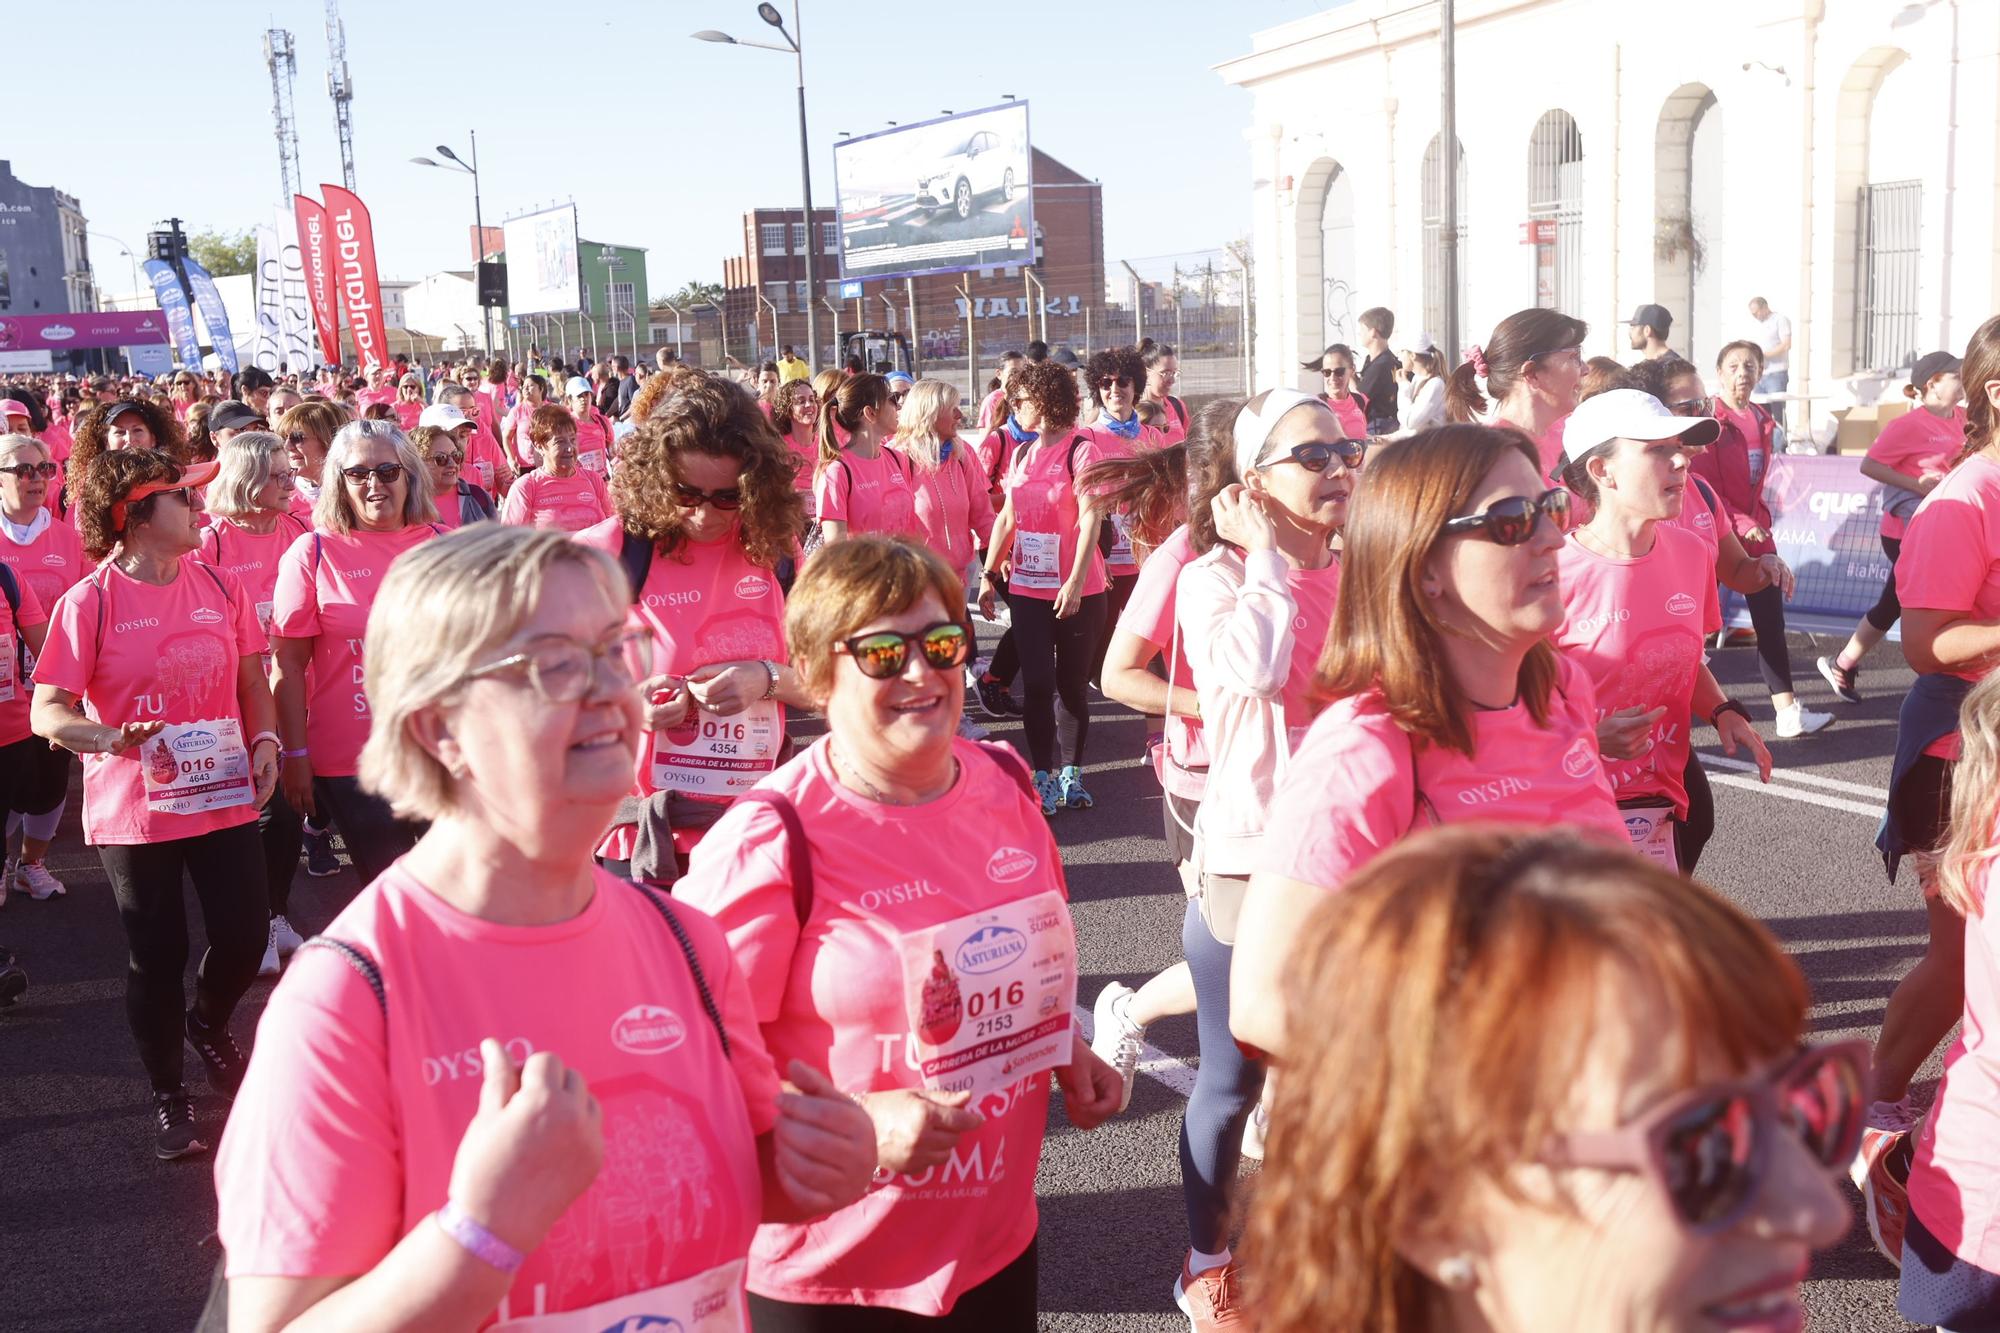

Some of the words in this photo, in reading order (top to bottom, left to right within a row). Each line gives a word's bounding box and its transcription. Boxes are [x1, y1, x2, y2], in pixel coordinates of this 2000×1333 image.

[91, 326, 120, 335] OYSHO
[1809, 490, 1868, 522] que
[230, 560, 263, 574] OYSHO
[1023, 554, 1040, 564] 016
[646, 590, 702, 608] OYSHO
[115, 616, 160, 634] OYSHO
[1577, 608, 1631, 633] OYSHO
[133, 693, 164, 716] TU
[702, 721, 745, 740] 016
[175, 738, 215, 749] ASTURIANA
[710, 742, 738, 755] 4354
[180, 756, 216, 774] 016
[669, 756, 706, 767] CARRERA
[707, 760, 719, 768] DE
[187, 772, 211, 784] 4643
[663, 771, 706, 785] OYSHO
[159, 789, 190, 799] CARRERA
[189, 787, 199, 795] DE
[212, 792, 246, 802] Santander
[158, 801, 191, 812] OYSHO
[1029, 917, 1060, 935] SUMA
[962, 940, 1023, 969] ASTURIANA
[967, 980, 1025, 1018] 016
[976, 1013, 1013, 1037] 2153
[421, 1036, 535, 1086] OYSO
[925, 1051, 974, 1075] CARRERA
[974, 1046, 989, 1058] DE
[989, 1042, 1004, 1053] LA
[1005, 1029, 1036, 1050] MUJER
[1012, 1043, 1059, 1068] Santander
